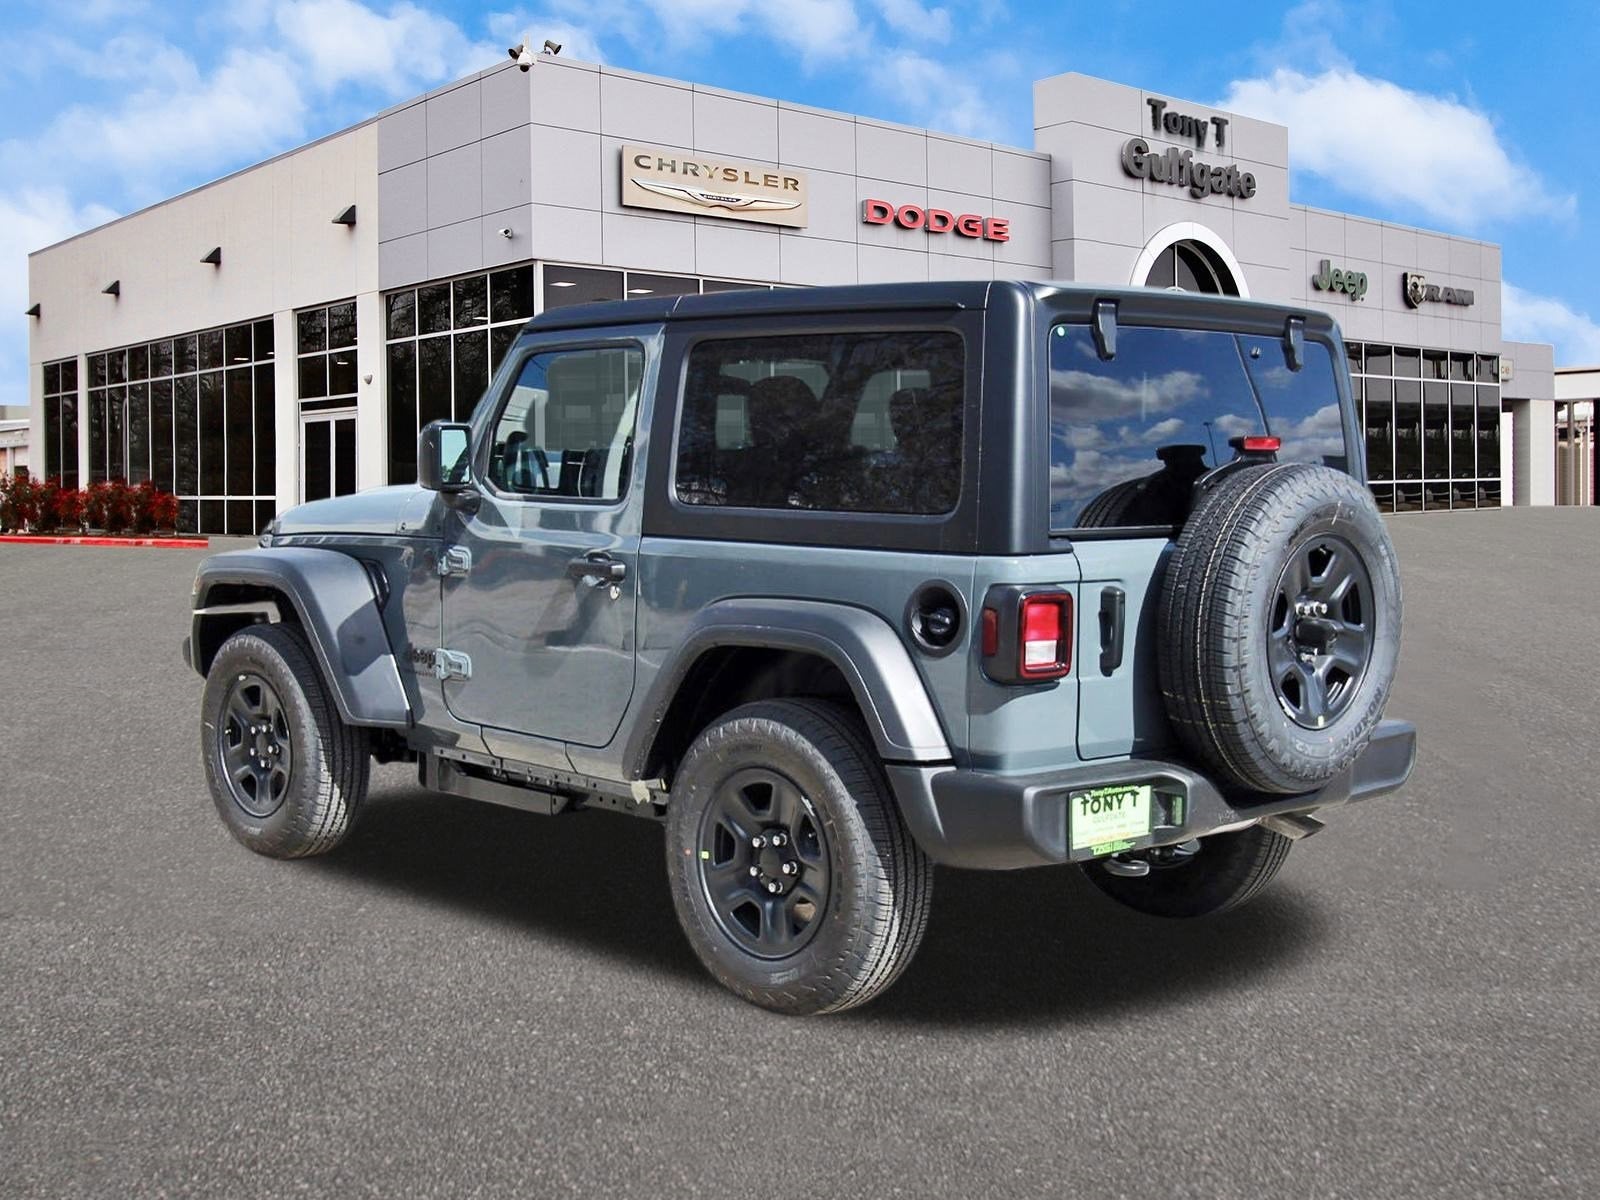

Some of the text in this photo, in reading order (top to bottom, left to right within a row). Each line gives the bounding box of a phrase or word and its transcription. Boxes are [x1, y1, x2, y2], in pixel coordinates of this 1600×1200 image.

[1147, 97, 1229, 148] Tony T
[633, 153, 801, 192] CHRYSLER
[1121, 137, 1257, 199] Gulfgate
[861, 198, 1010, 243] DODGE
[1312, 259, 1368, 302] Jeep
[1424, 284, 1475, 306] RAM
[1080, 792, 1125, 816] TONY
[1130, 790, 1140, 807] T
